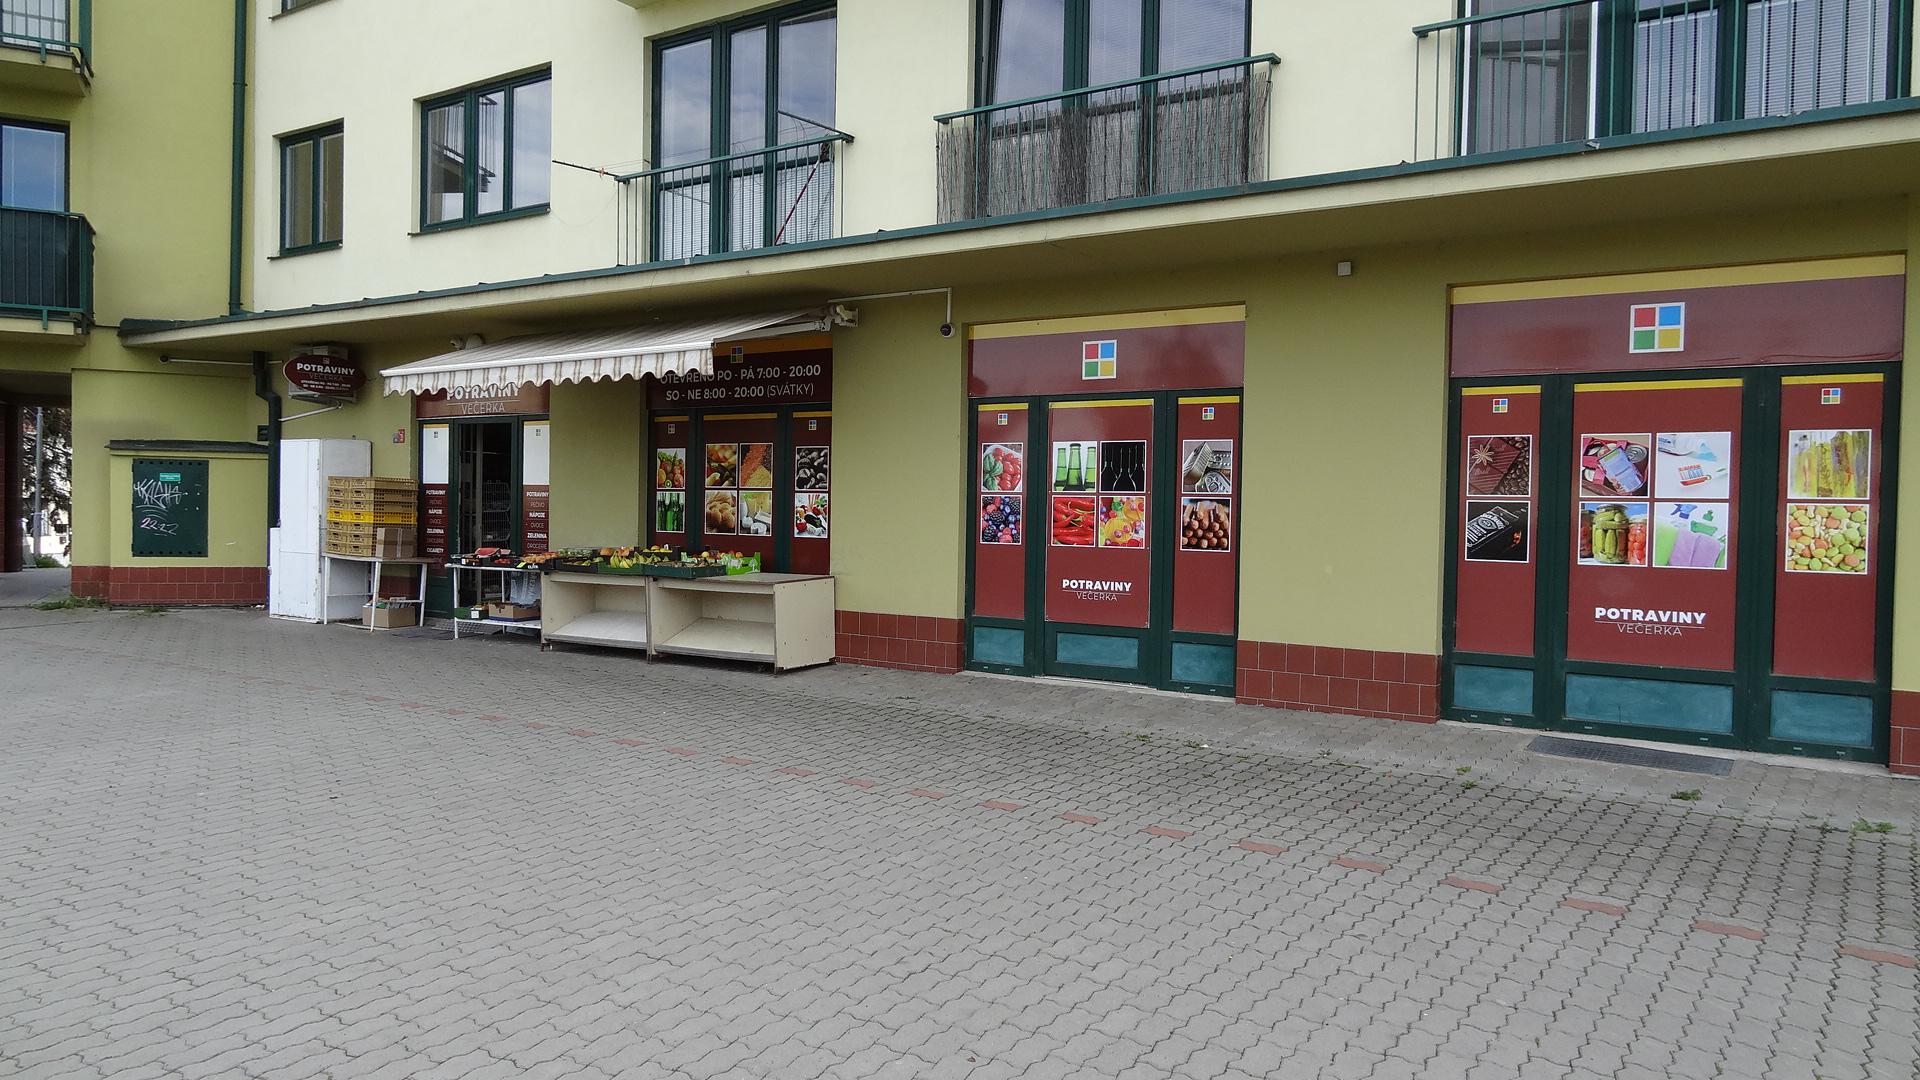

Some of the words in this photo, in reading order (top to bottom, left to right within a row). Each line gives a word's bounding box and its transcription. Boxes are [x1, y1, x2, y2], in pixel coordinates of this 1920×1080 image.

[296, 362, 355, 376] POTRAVINY
[717, 370, 732, 381] PO
[740, 366, 755, 380] PÁ
[756, 367, 780, 379] 7:00
[789, 364, 821, 377] 20:00
[666, 390, 680, 401] SO
[687, 388, 701, 400] NE
[703, 387, 726, 399] 8:00
[734, 386, 764, 398] 20:00
[766, 382, 814, 398] (SVÁTKY)
[461, 400, 506, 415] VEČERKA
[1062, 579, 1132, 592] POTRAVINY
[1076, 590, 1118, 602] VEČERKA
[1594, 607, 1707, 625] POTRAVINY
[1617, 622, 1683, 637] VEČERKA
